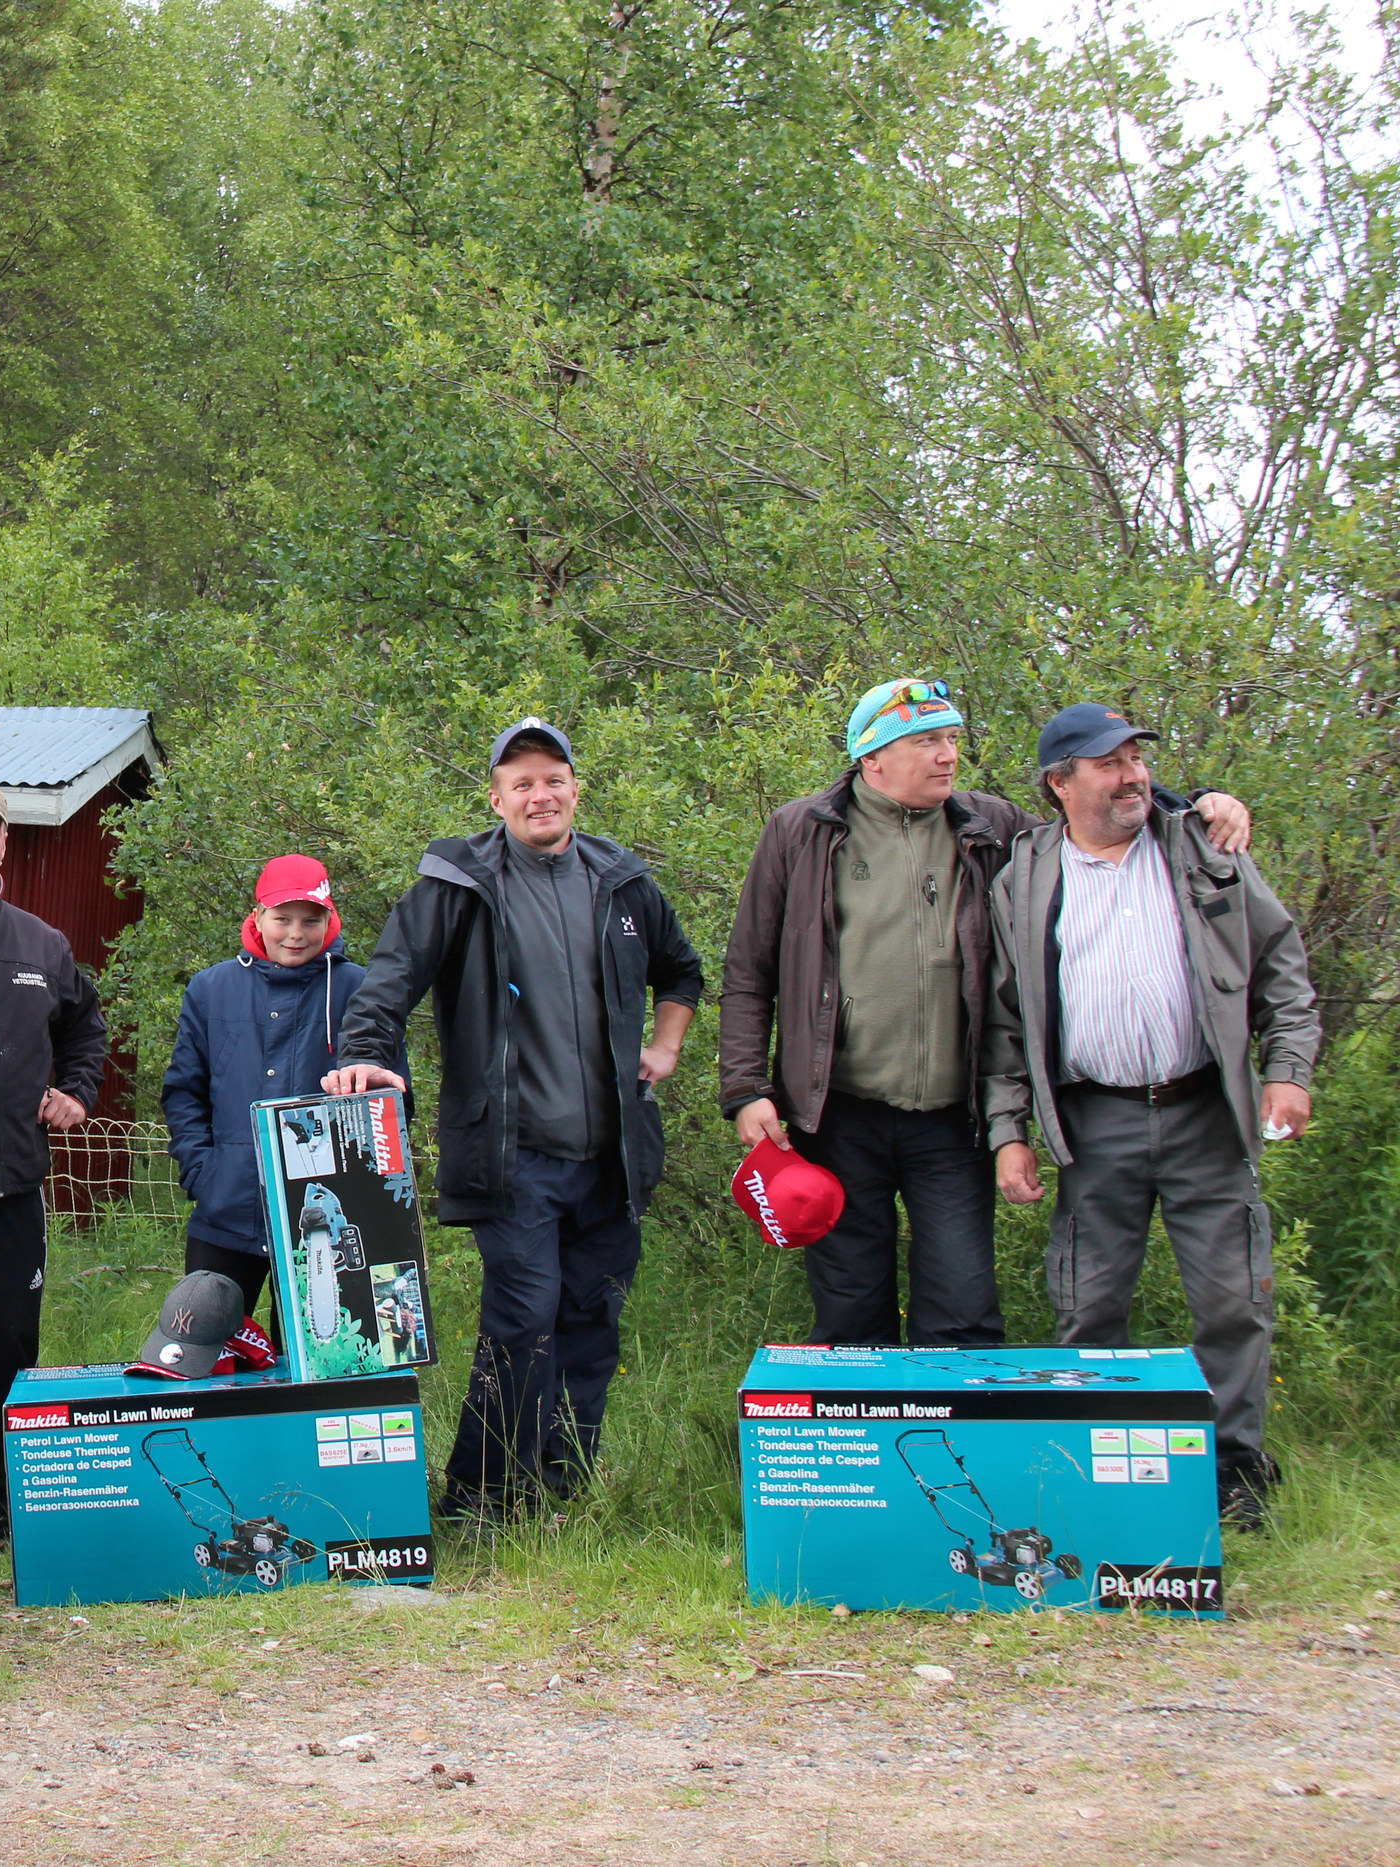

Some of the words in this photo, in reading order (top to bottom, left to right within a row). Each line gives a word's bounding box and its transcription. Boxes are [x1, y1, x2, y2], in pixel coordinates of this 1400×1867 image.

[73, 1411, 110, 1425] Petrol
[113, 1409, 148, 1424] Lawn
[150, 1406, 194, 1420] Mower
[816, 1403, 856, 1417] Petrol
[860, 1403, 900, 1417] Lawn
[903, 1403, 952, 1418] Mower
[757, 1426, 791, 1436] Petrol
[794, 1426, 825, 1437] Lawn
[828, 1426, 867, 1437] Mower
[20, 1436, 51, 1447] Petrol
[54, 1435, 82, 1445] Lawn
[84, 1433, 119, 1443] Mower
[757, 1440, 814, 1451] Tondeuse
[816, 1440, 879, 1453] Thermique
[21, 1449, 72, 1460] Tondeuse
[74, 1446, 130, 1458] Thermique
[22, 1461, 74, 1473] Cortadora
[76, 1460, 90, 1471] de
[92, 1458, 132, 1470] Cesped
[758, 1454, 816, 1465] Cortadora
[818, 1454, 834, 1465] de
[836, 1455, 880, 1467] Cesped
[758, 1470, 765, 1478] a
[768, 1468, 819, 1479] Gasolina
[22, 1478, 29, 1486] a
[31, 1475, 78, 1486] Gasolina
[24, 1485, 129, 1499] Benzin-Rasenmäher
[760, 1482, 875, 1494] Benzin-Rasenmäher
[25, 1499, 140, 1512] Бензогазонокосилка
[760, 1496, 887, 1508] Бензогазонокосилка
[328, 1546, 427, 1571] PLM4819
[1100, 1576, 1218, 1599] PLM4817
